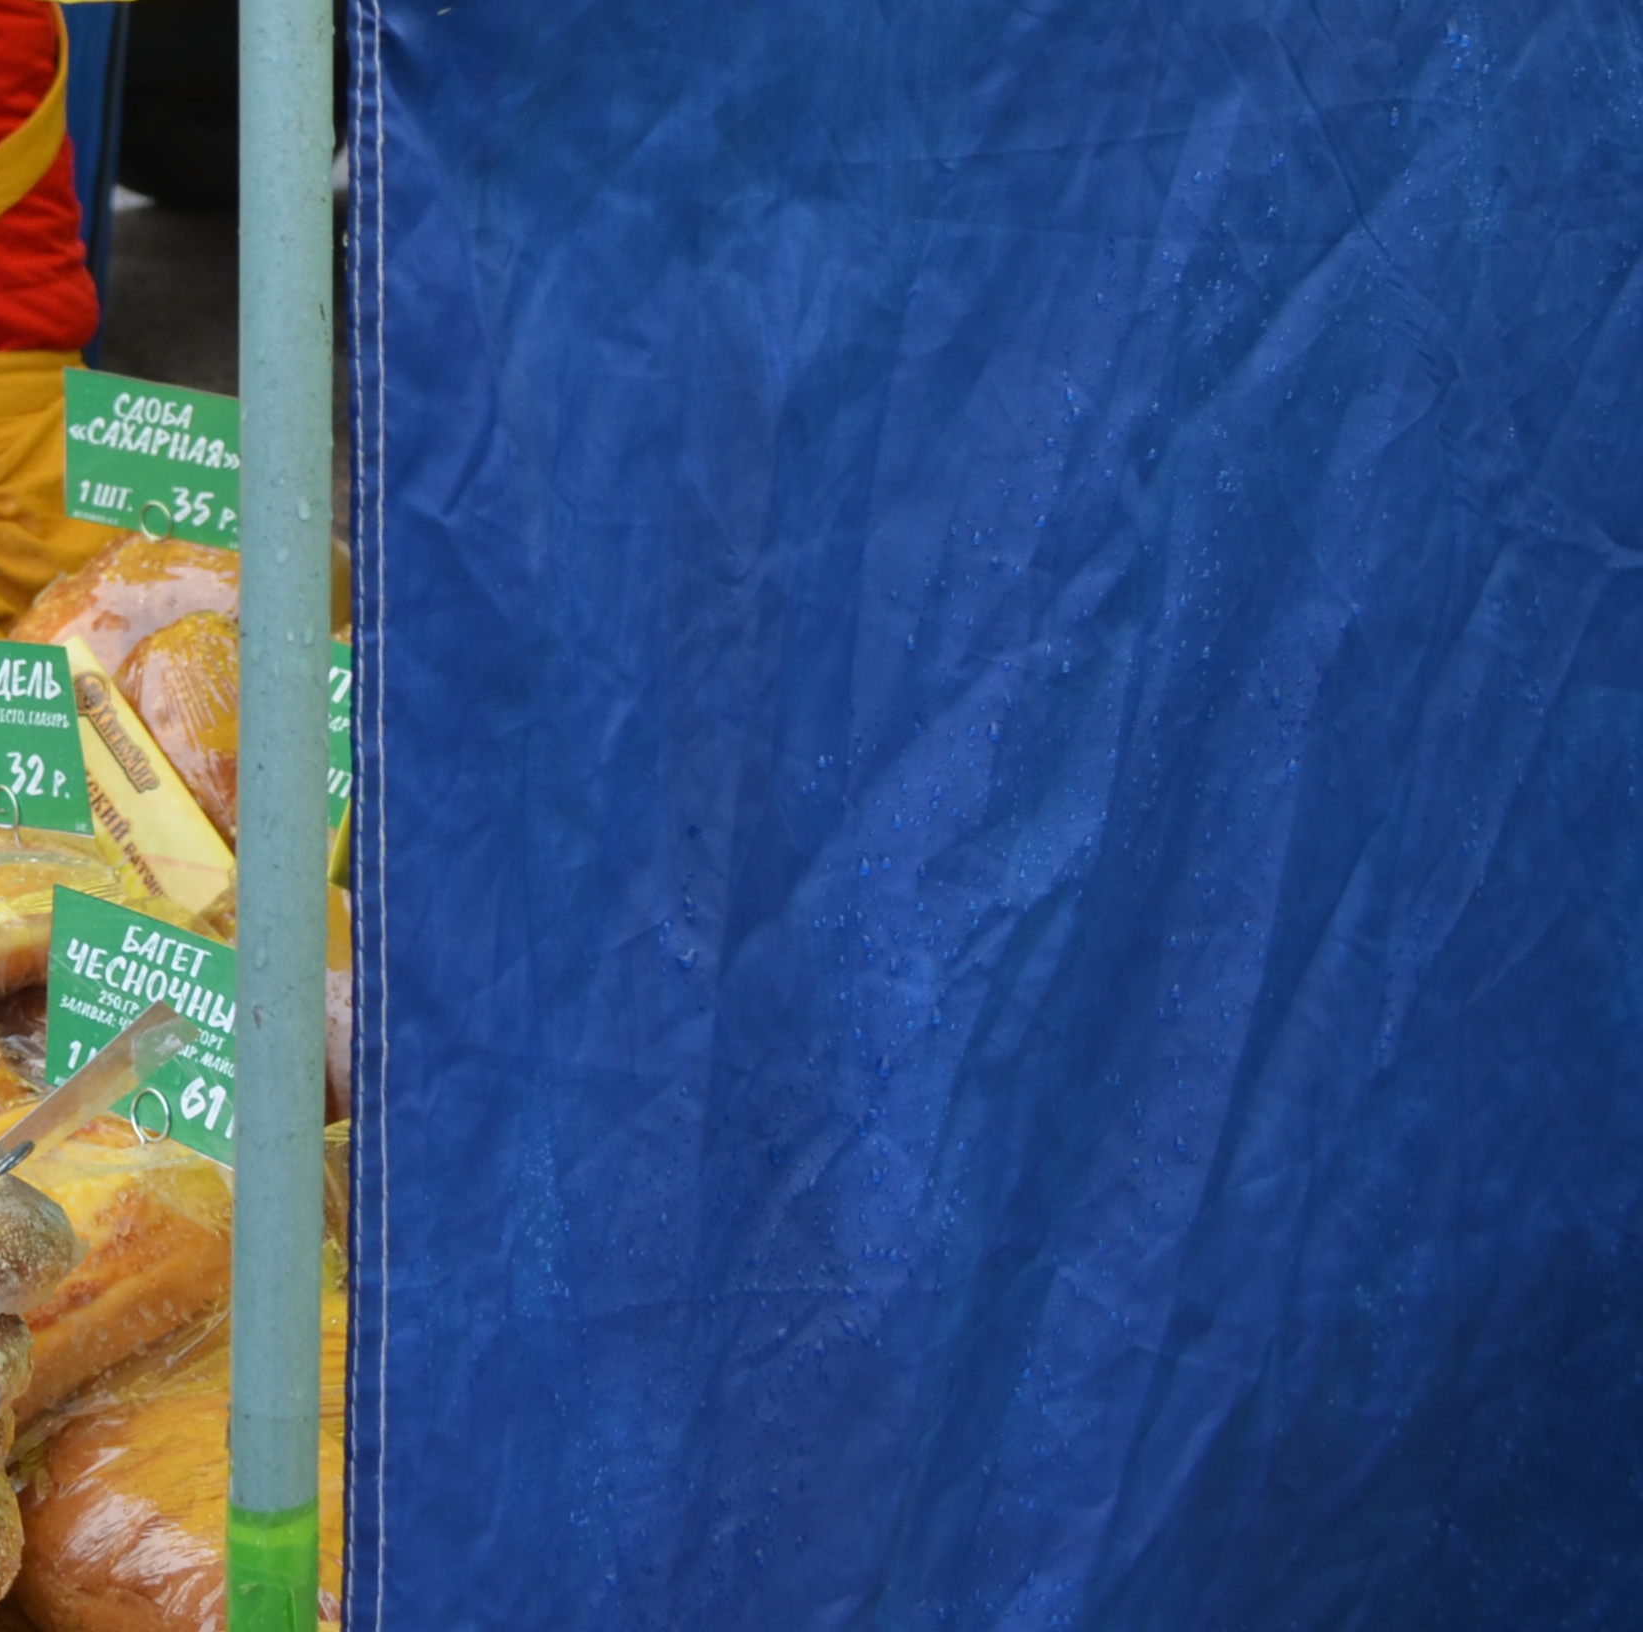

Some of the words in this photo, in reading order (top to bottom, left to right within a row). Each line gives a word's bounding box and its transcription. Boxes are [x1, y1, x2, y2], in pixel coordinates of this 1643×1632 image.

[113, 392, 194, 429] СДОБА
[69, 416, 240, 469] «САХАРНАЯ»
[80, 480, 91, 503] 1
[93, 482, 133, 512] ШТ.
[172, 487, 214, 527] 35
[218, 507, 238, 533] Р.
[28, 710, 70, 729] ГЛАЗУРЬ
[6, 751, 44, 796] 32
[52, 769, 70, 800] Р.
[122, 925, 212, 978] БАГЕТ
[59, 995, 117, 1027] ЗАЛИВКА:
[67, 938, 236, 1034] ЧЕСНОЧНЫ
[180, 1076, 226, 1131] 61
